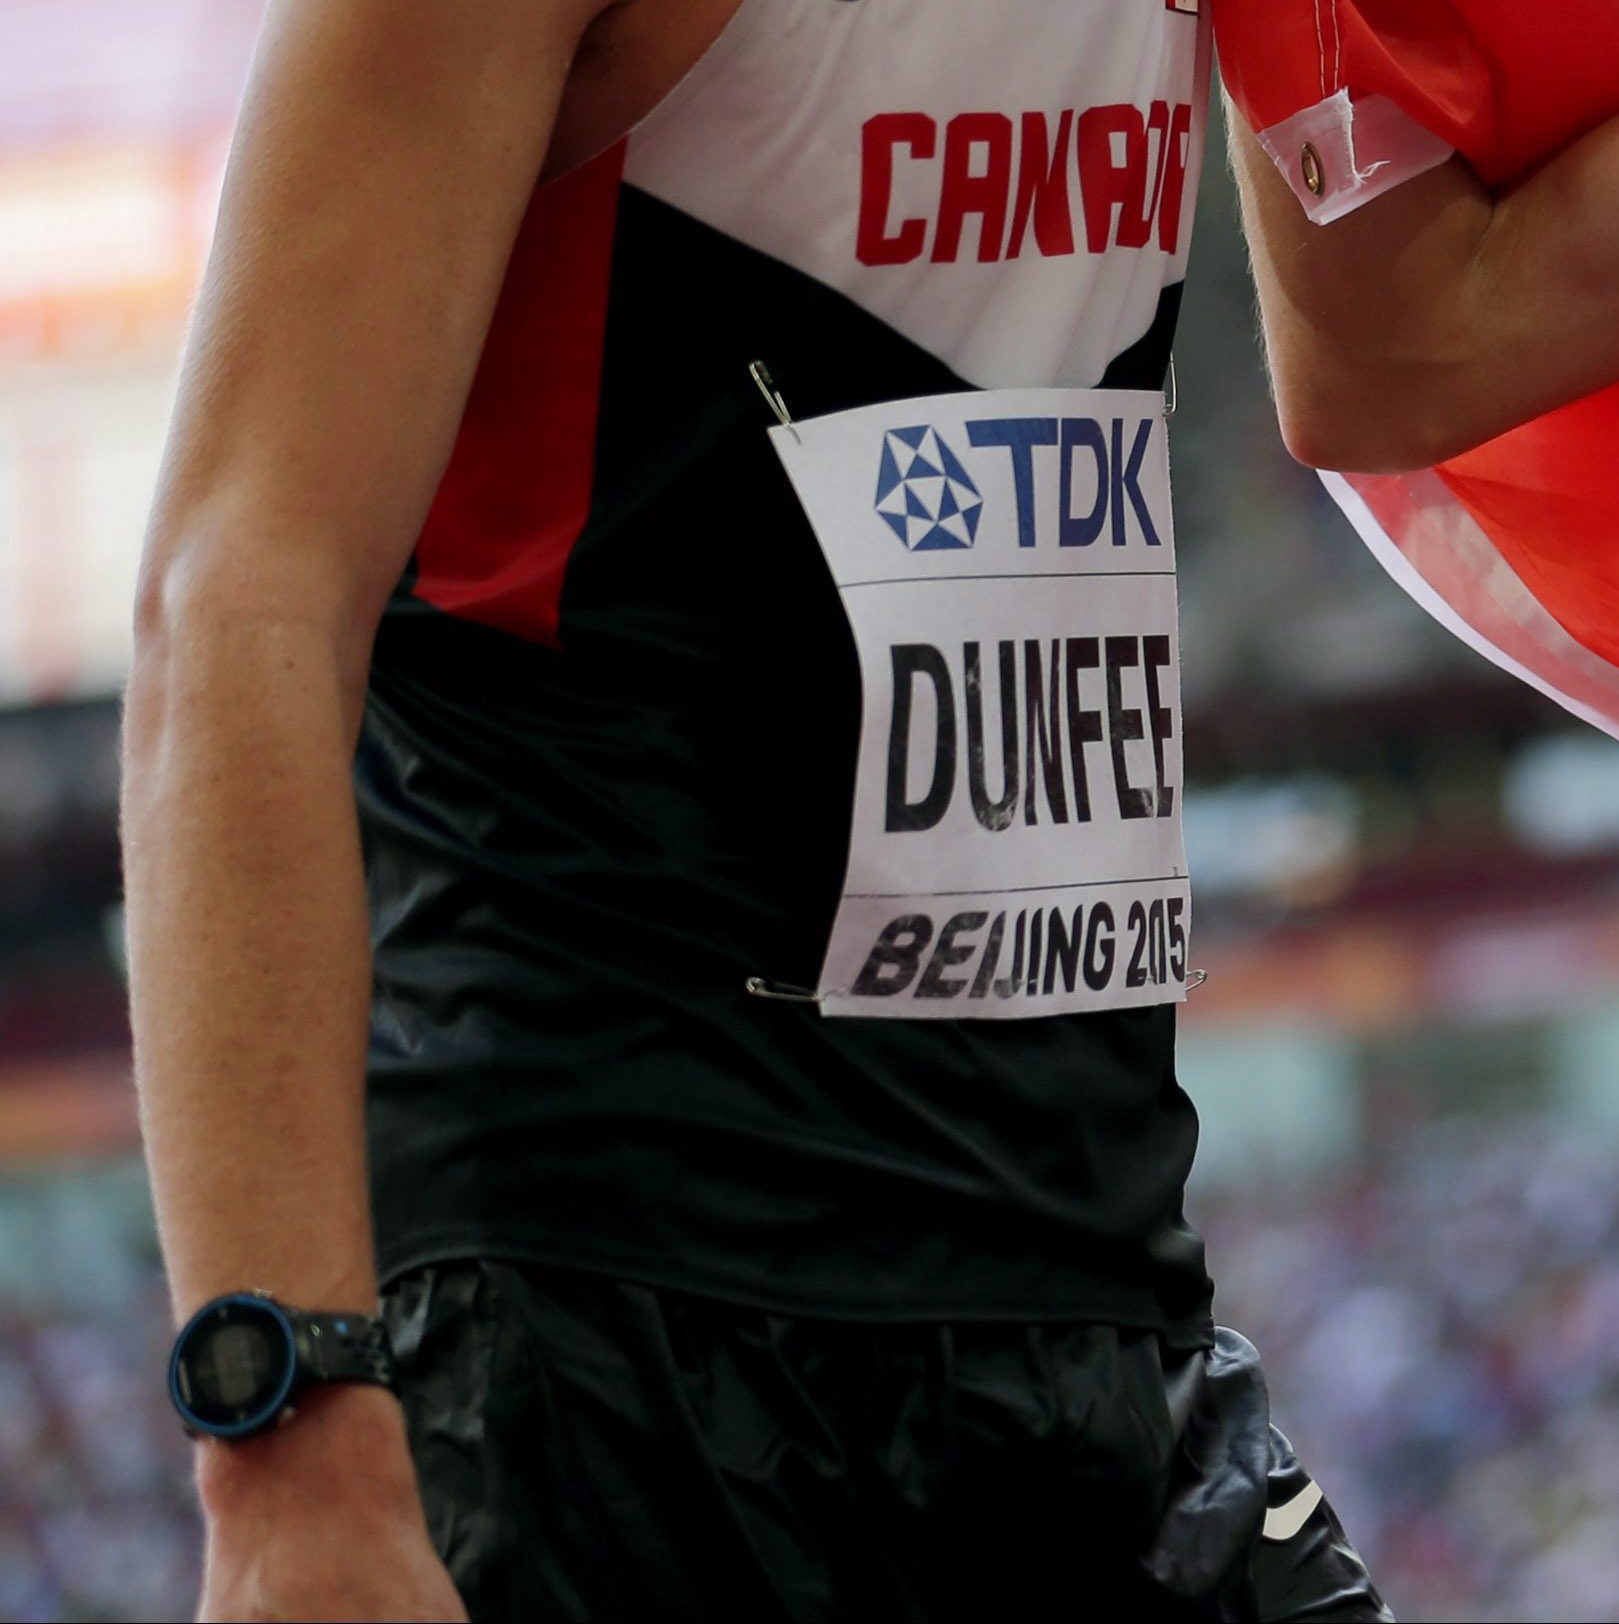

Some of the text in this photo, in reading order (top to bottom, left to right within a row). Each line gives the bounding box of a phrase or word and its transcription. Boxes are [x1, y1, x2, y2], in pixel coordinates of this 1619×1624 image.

[965, 417, 1161, 547] TDK
[884, 634, 1174, 833] DUNFEE
[850, 901, 1116, 999] BEIJING
